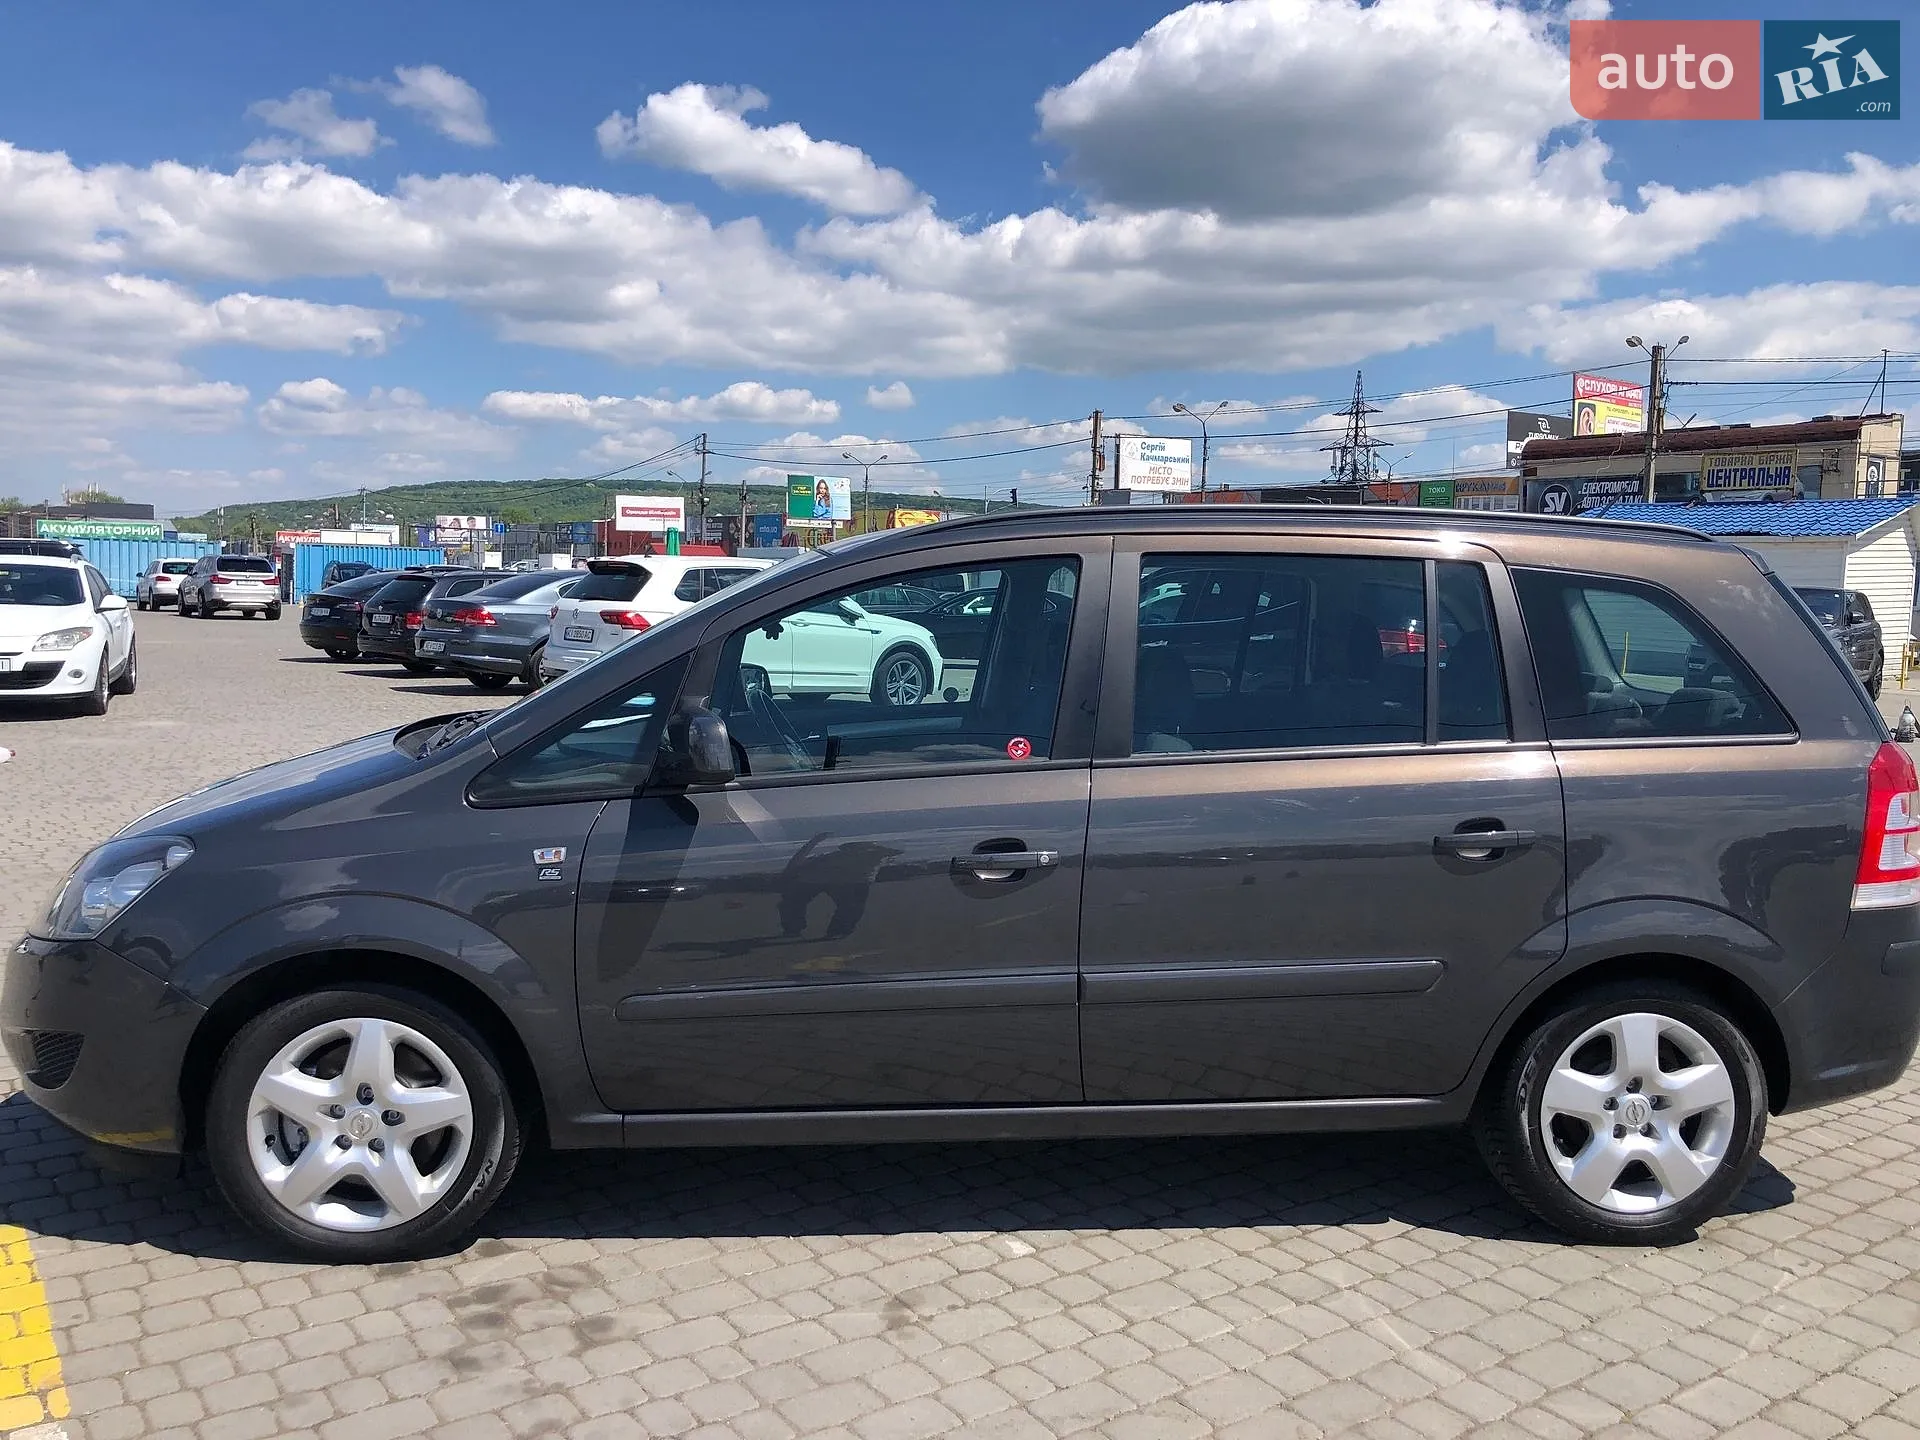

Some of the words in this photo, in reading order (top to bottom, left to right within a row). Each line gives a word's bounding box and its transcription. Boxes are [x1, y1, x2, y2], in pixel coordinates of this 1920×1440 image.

[1140, 441, 1166, 453] Сергій
[1140, 452, 1190, 464] Качмарський
[1708, 455, 1754, 467] ТОВАРНА
[1148, 466, 1173, 475] МІСТО
[1130, 475, 1171, 485] ПОТРЕБУЄ
[1171, 477, 1189, 486] ЗМІН
[1706, 466, 1792, 488] ЦЕНТРАЛЬНА
[1543, 491, 1567, 512] SV
[40, 522, 160, 536] АКУМУЛЯТОРНИЙ
[278, 535, 321, 543] АКУМУЛЯ
